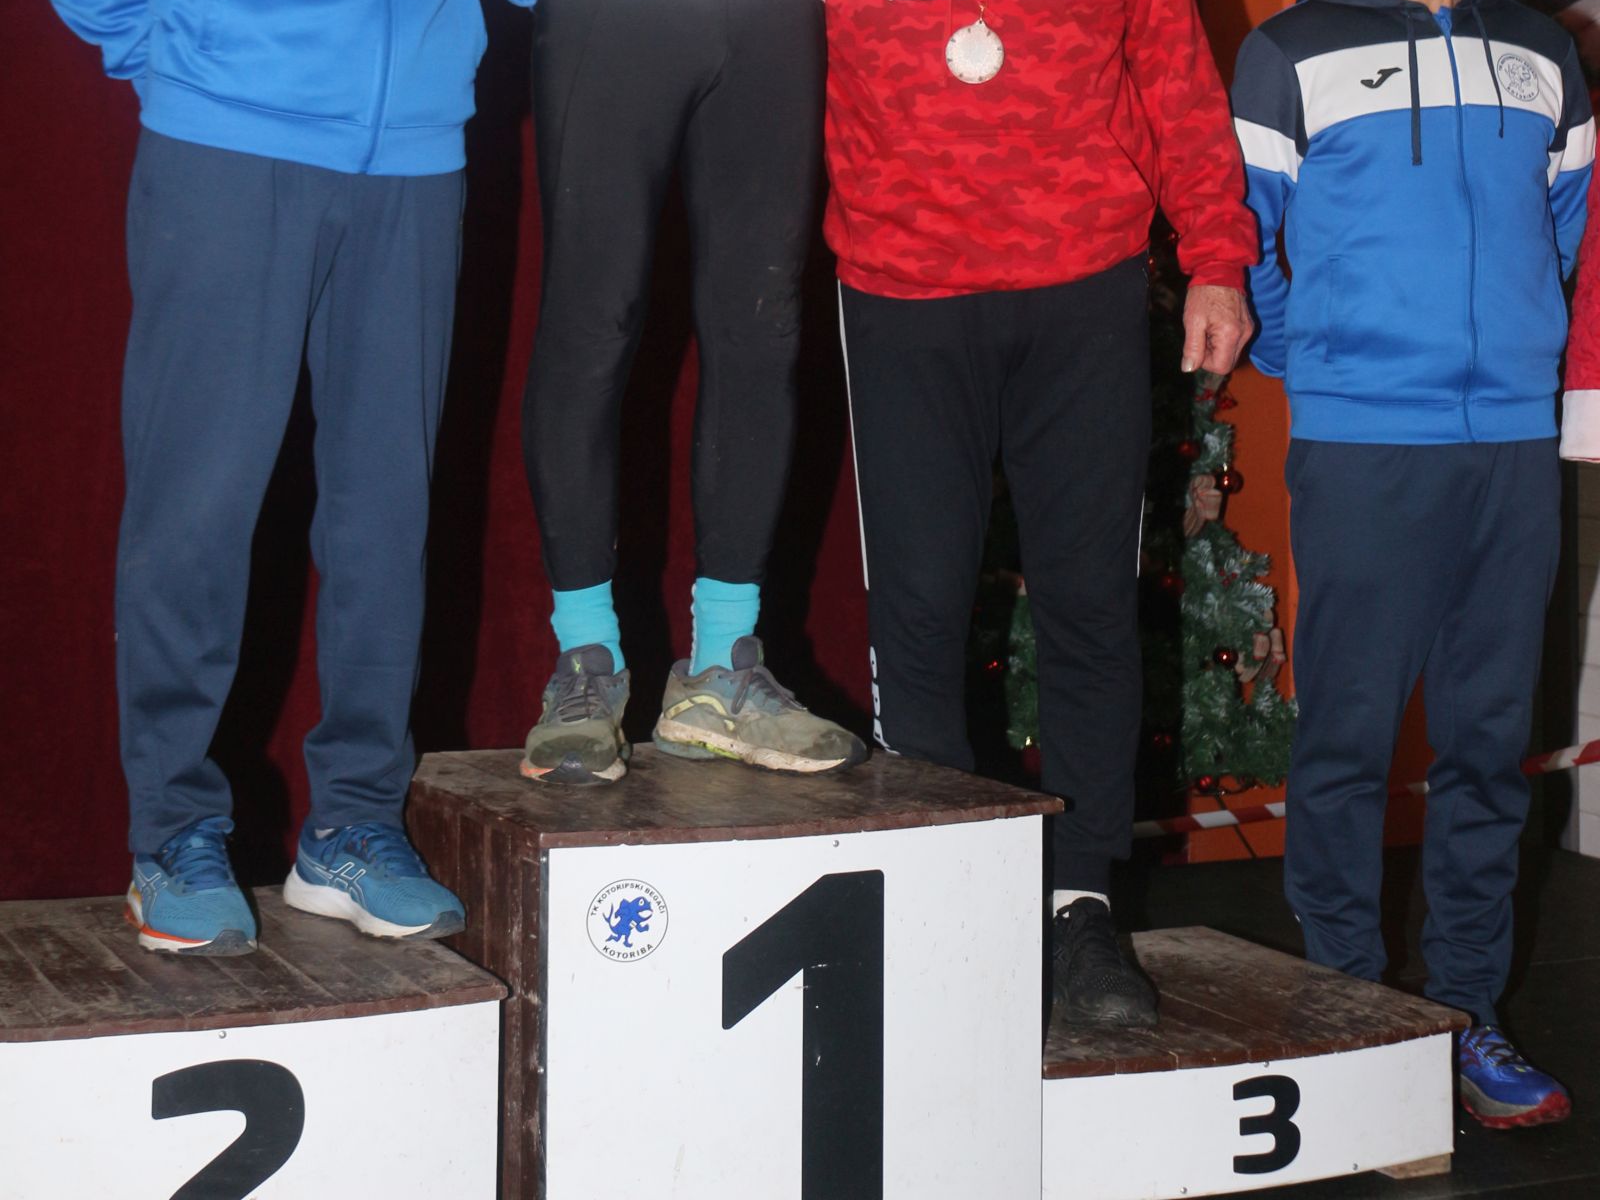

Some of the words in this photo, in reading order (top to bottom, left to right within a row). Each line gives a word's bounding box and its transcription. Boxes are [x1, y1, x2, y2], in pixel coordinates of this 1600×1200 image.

[590, 906, 599, 916] TK
[645, 888, 666, 914] BEGAČI
[603, 944, 653, 960] KOTORIBA
[722, 869, 885, 1200] 1
[152, 1059, 305, 1200] 2
[1233, 1075, 1301, 1174] 3
